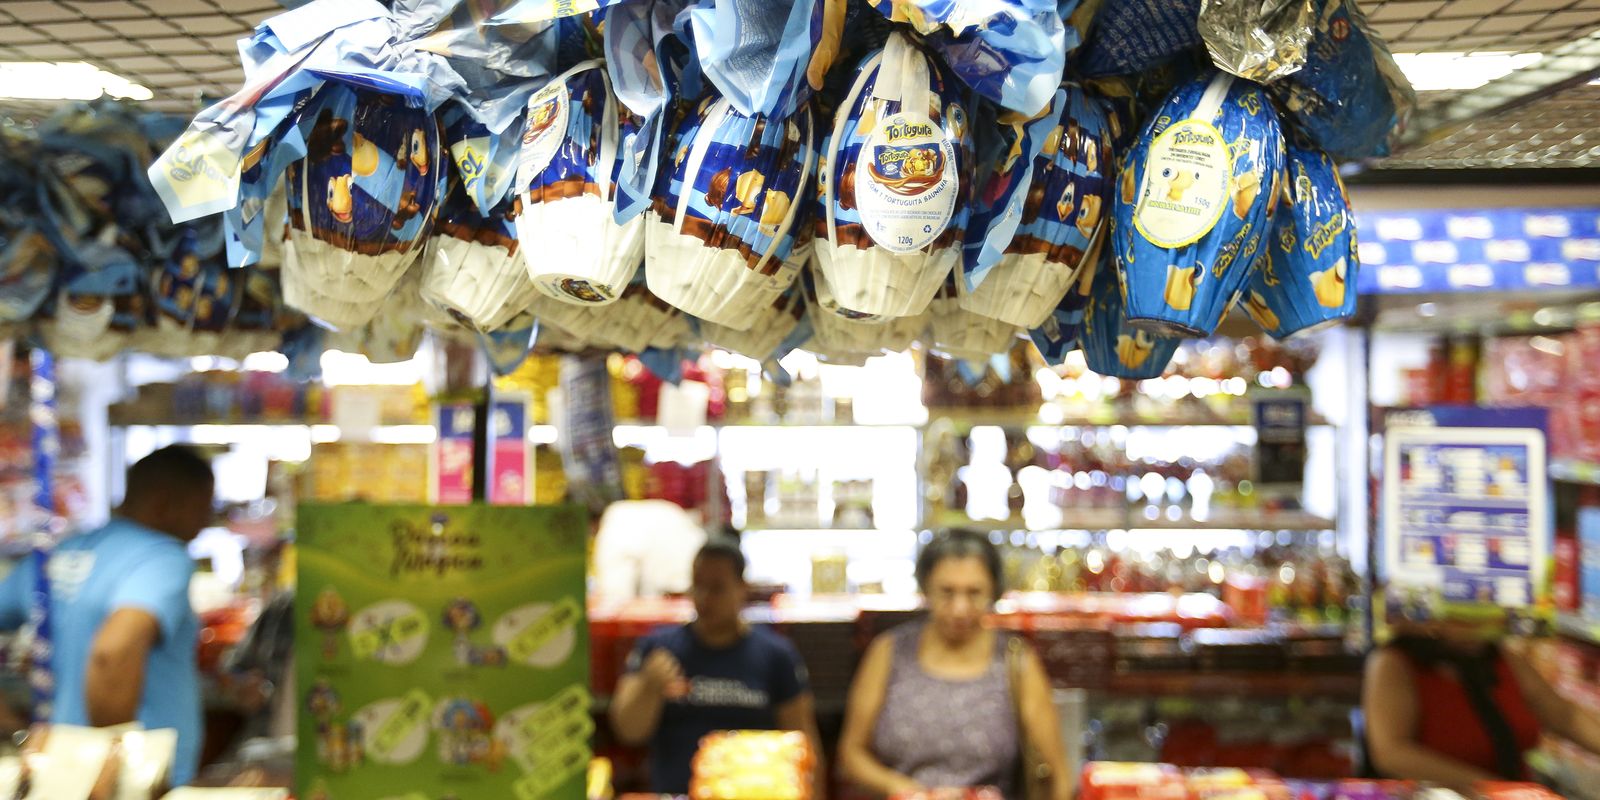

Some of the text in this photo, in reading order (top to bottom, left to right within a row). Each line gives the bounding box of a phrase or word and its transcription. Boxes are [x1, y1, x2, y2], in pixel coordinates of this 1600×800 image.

[885, 124, 932, 141] Tortuguita
[884, 195, 922, 206] TORTUGUITA
[924, 179, 948, 203] BAUNILHA
[898, 236, 913, 246] 120g
